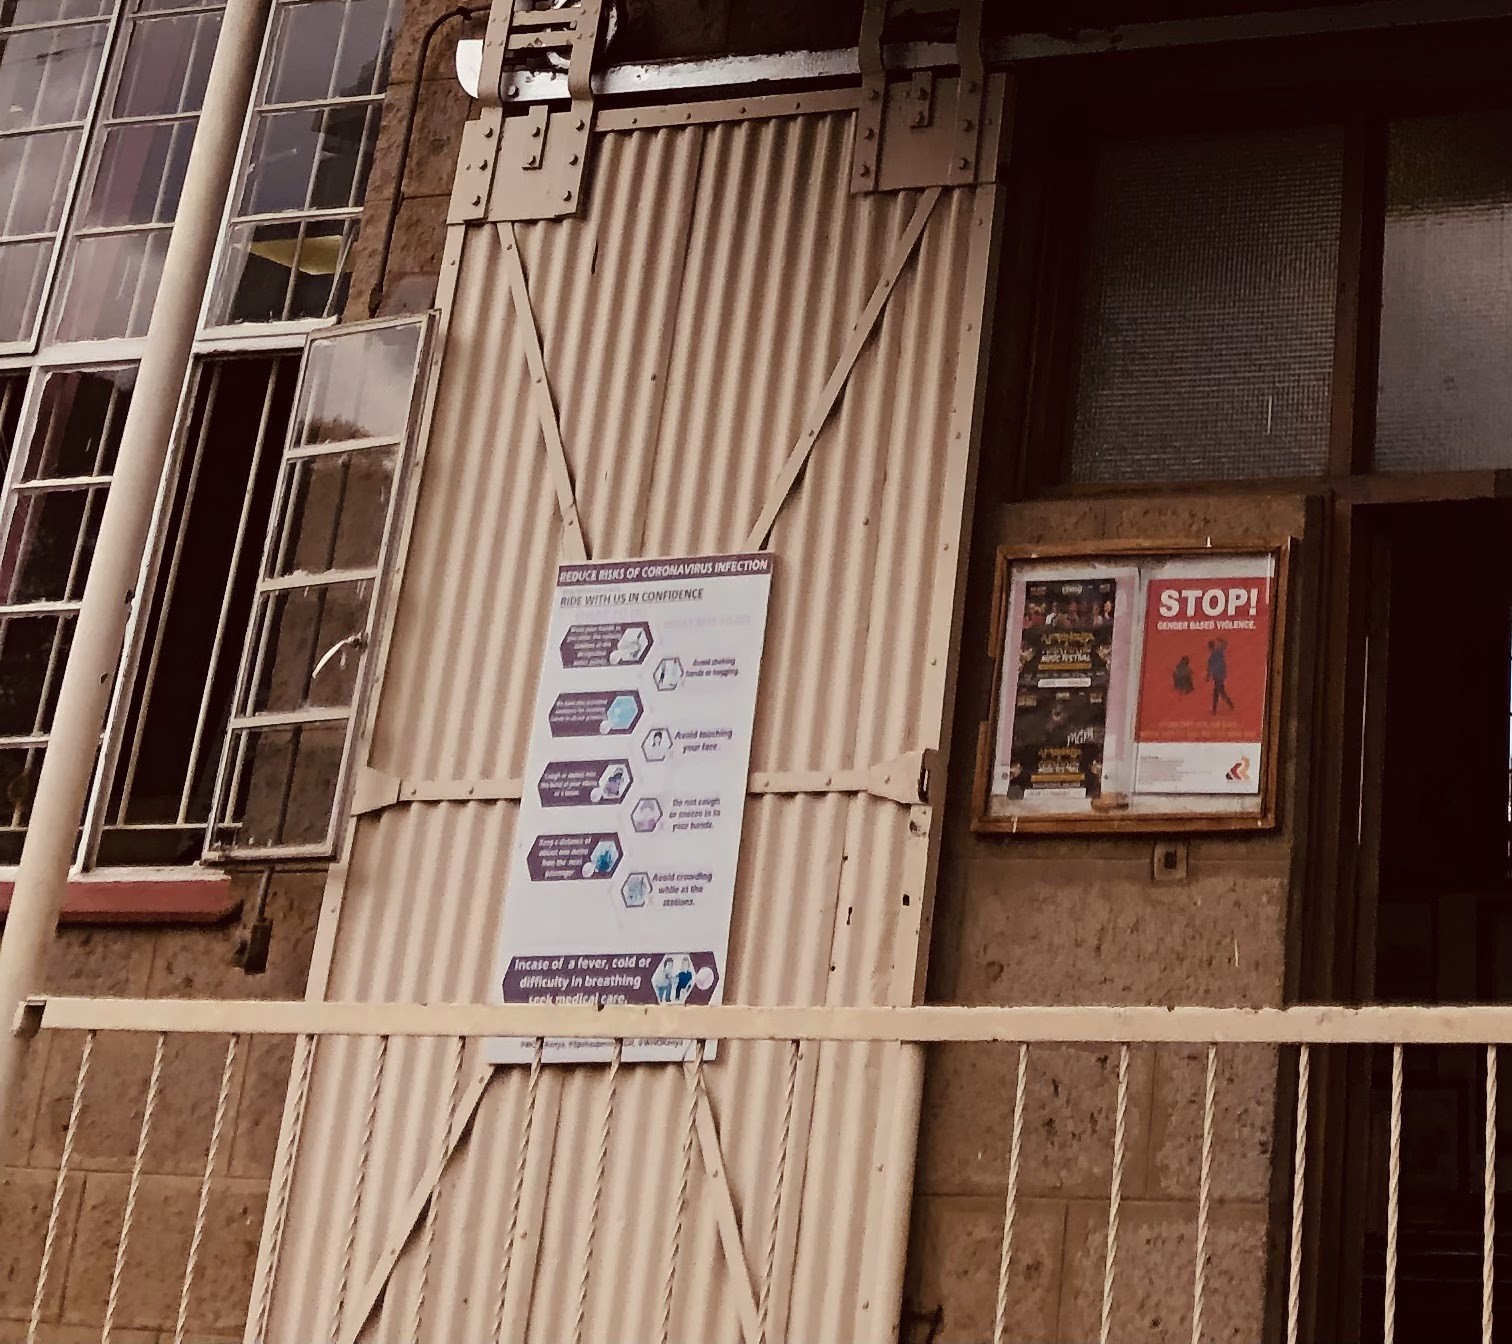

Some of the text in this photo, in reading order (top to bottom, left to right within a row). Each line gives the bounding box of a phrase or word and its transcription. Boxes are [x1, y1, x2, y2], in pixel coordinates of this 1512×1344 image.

[559, 558, 769, 583] REDUCE RISKS OF CORONAVIRUS INFECTION
[560, 588, 704, 607] RIDE WITH US IN CONFIDENCE
[1158, 588, 1259, 617] STOP!
[674, 728, 733, 741] Avoid touching
[672, 798, 682, 808] Do
[698, 797, 722, 808] cough
[652, 872, 713, 884] Avoid crowding
[690, 885, 704, 894] the
[515, 956, 652, 971] Incase of a fever, cold or
[519, 974, 642, 991] difficulty in breathing
[555, 993, 599, 1004] medical
